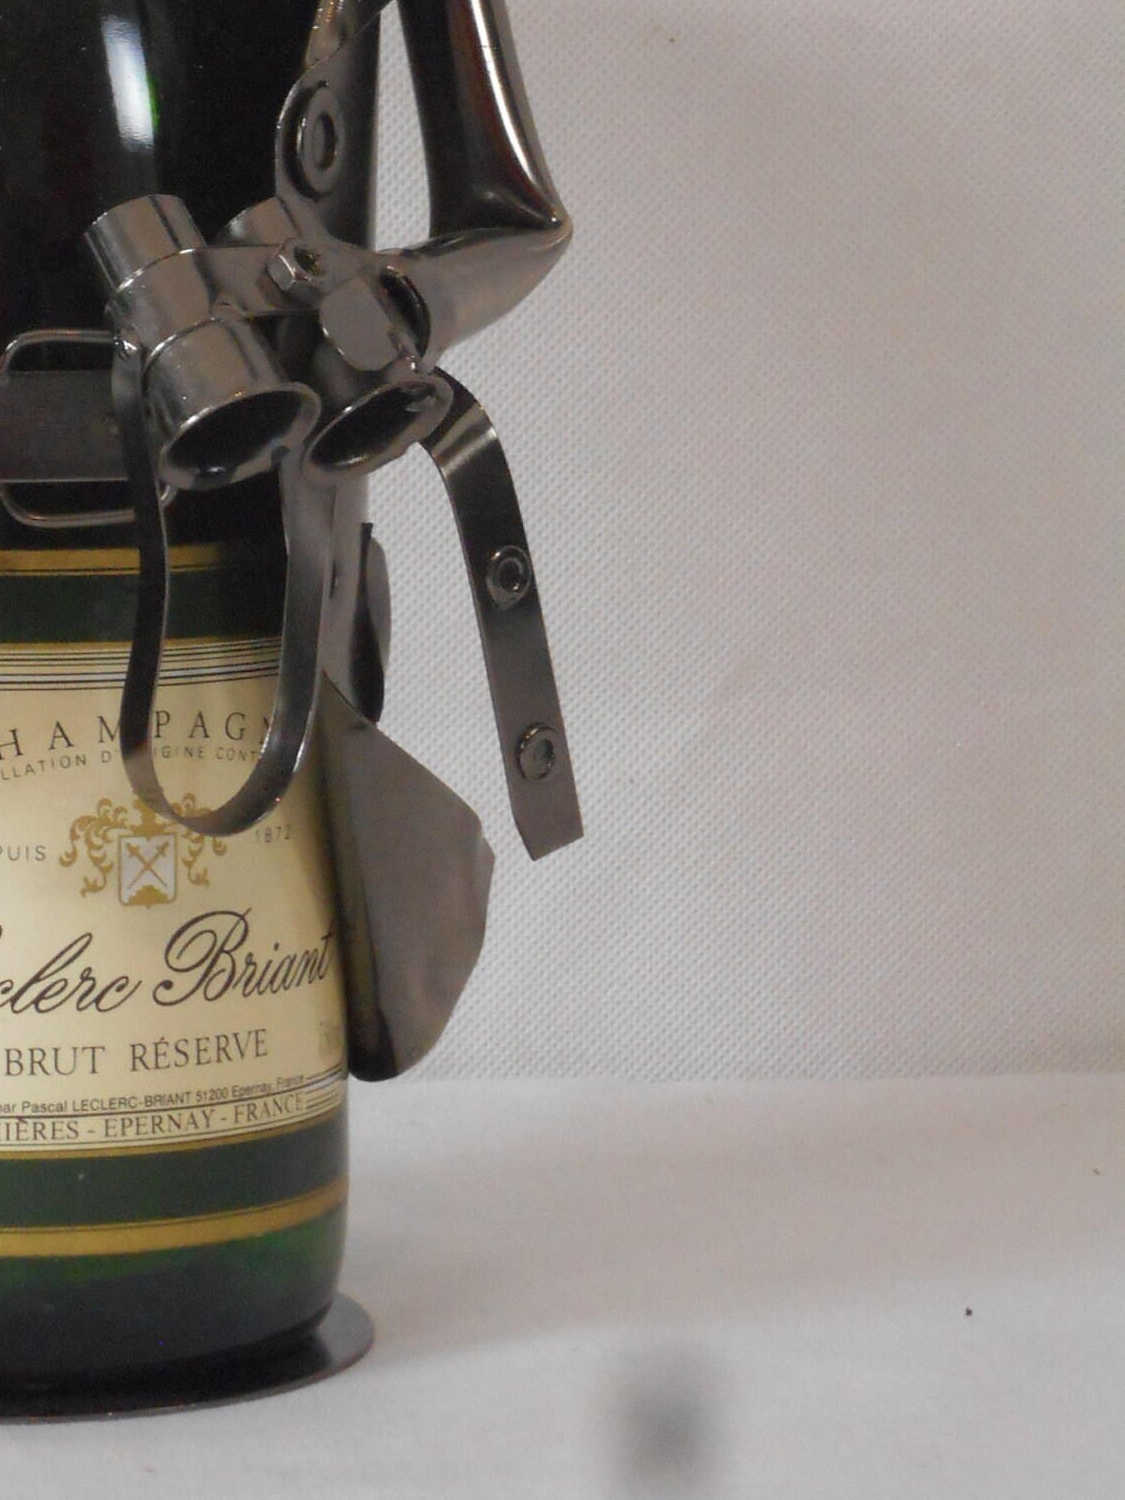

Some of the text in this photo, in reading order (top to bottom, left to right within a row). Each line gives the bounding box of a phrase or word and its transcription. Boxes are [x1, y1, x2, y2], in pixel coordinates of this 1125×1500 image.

[101, 744, 206, 765] D'IGINE
[255, 825, 292, 845] 1872
[152, 908, 335, 1007] Briant
[3, 1028, 269, 1078] BRUT RÉSERVE
[22, 1100, 68, 1114] Pascal
[72, 1091, 192, 1112] LECLERC-BRIANT
[195, 1086, 229, 1103] 51200
[103, 1108, 216, 1138] EPERNAY
[234, 1092, 307, 1125] FRANCE
